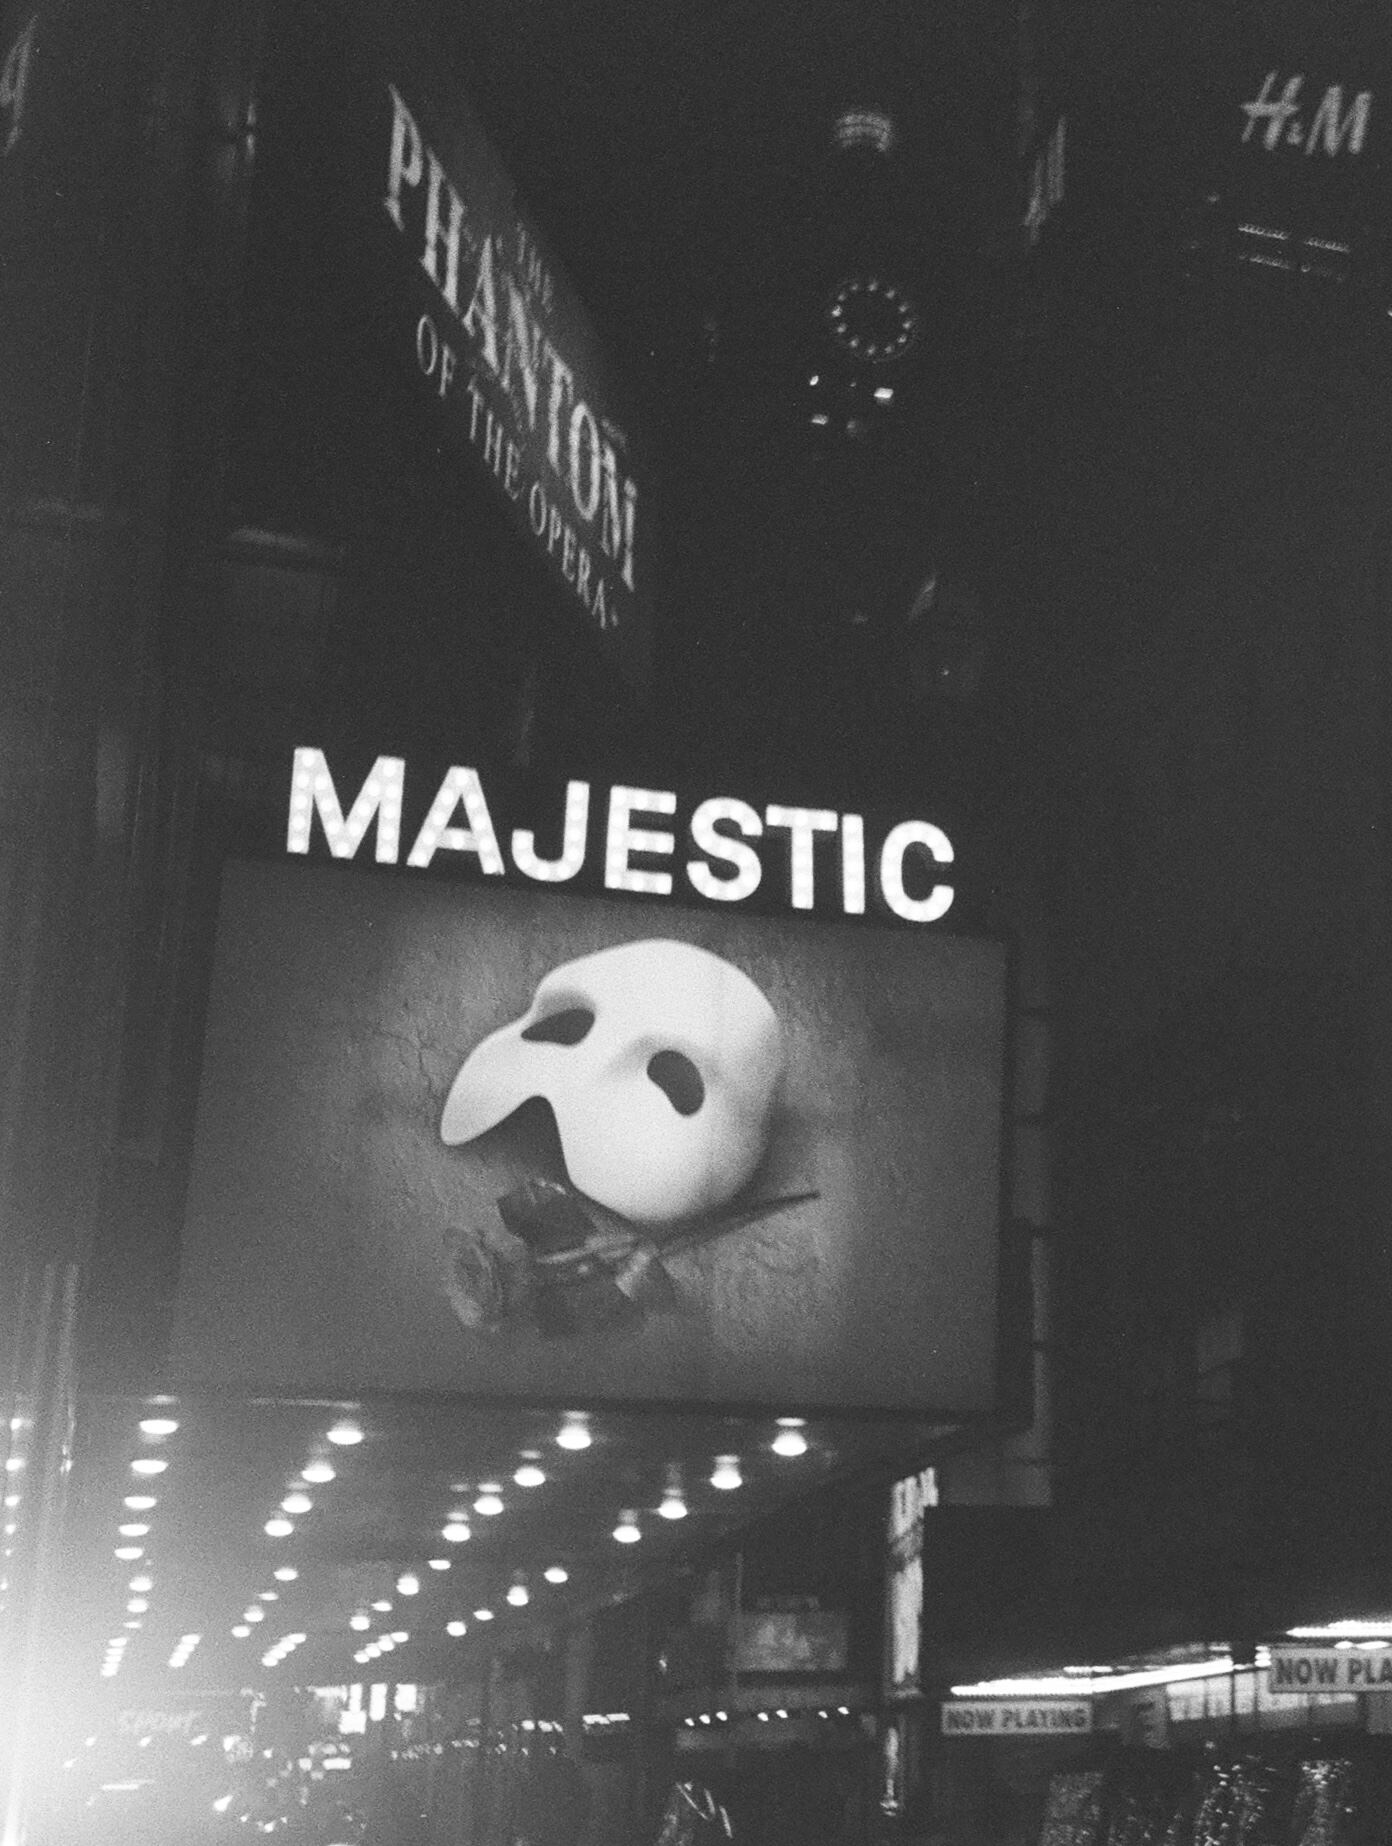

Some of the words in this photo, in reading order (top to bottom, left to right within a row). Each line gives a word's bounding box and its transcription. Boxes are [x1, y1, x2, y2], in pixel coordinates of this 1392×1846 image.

[1239, 70, 1373, 157] H&M
[384, 83, 639, 591] PHANTOM
[416, 314, 457, 397] OF
[467, 374, 525, 499] THE
[529, 478, 610, 631] OPERA
[286, 745, 956, 923] MAJESTIC
[946, 1708, 995, 1730] NOW
[1000, 1707, 1088, 1730] PLAYING
[1275, 1656, 1338, 1685] NOW
